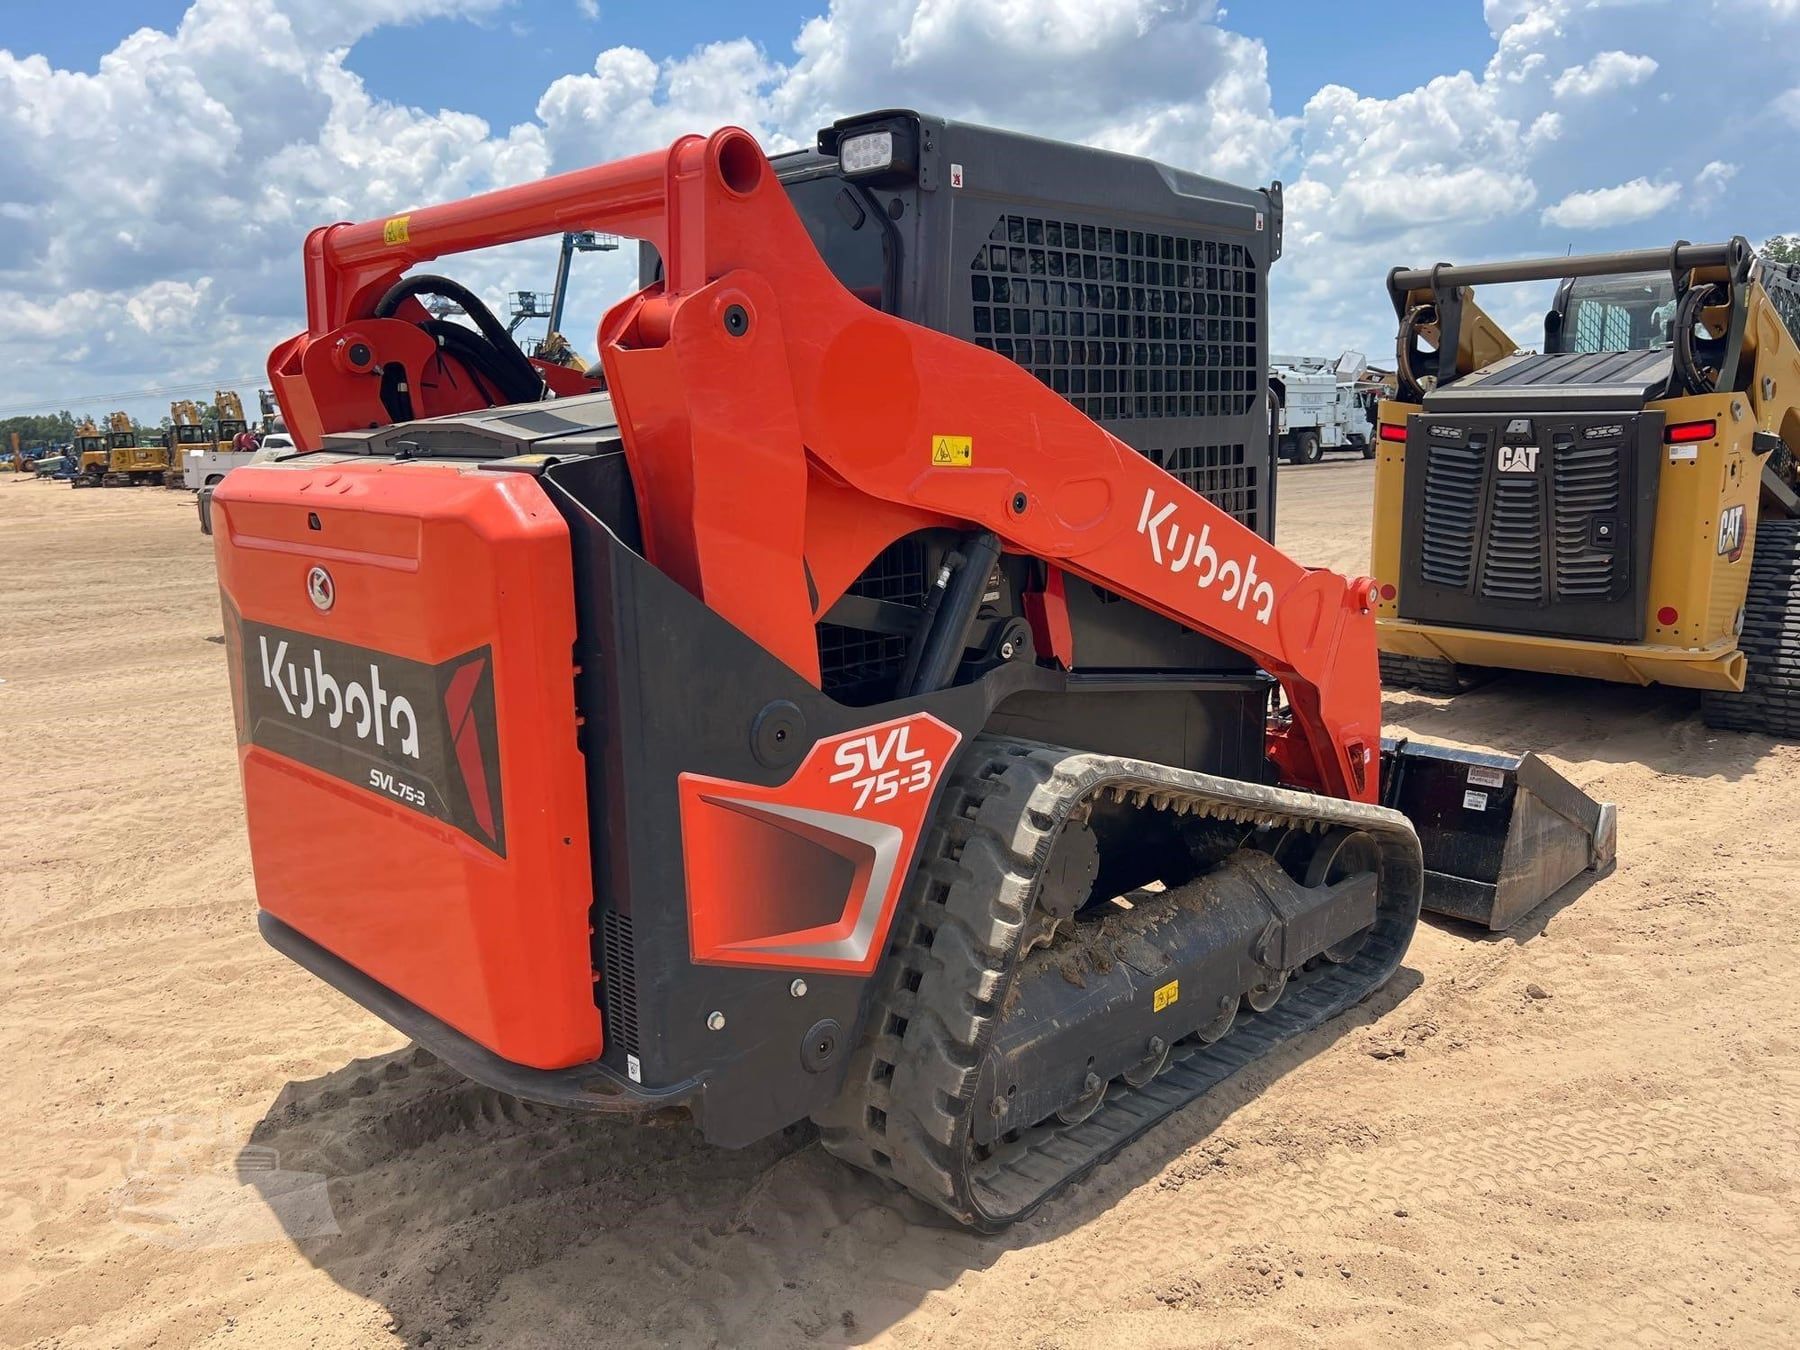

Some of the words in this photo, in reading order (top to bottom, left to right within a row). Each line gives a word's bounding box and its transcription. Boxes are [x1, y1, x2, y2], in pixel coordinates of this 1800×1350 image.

[1497, 446, 1540, 473] CAT
[1136, 488, 1274, 625] Kubota
[1718, 506, 1743, 554] CAT
[259, 636, 419, 759] Kubota
[829, 726, 925, 783] SVL
[852, 760, 932, 811] 75-3
